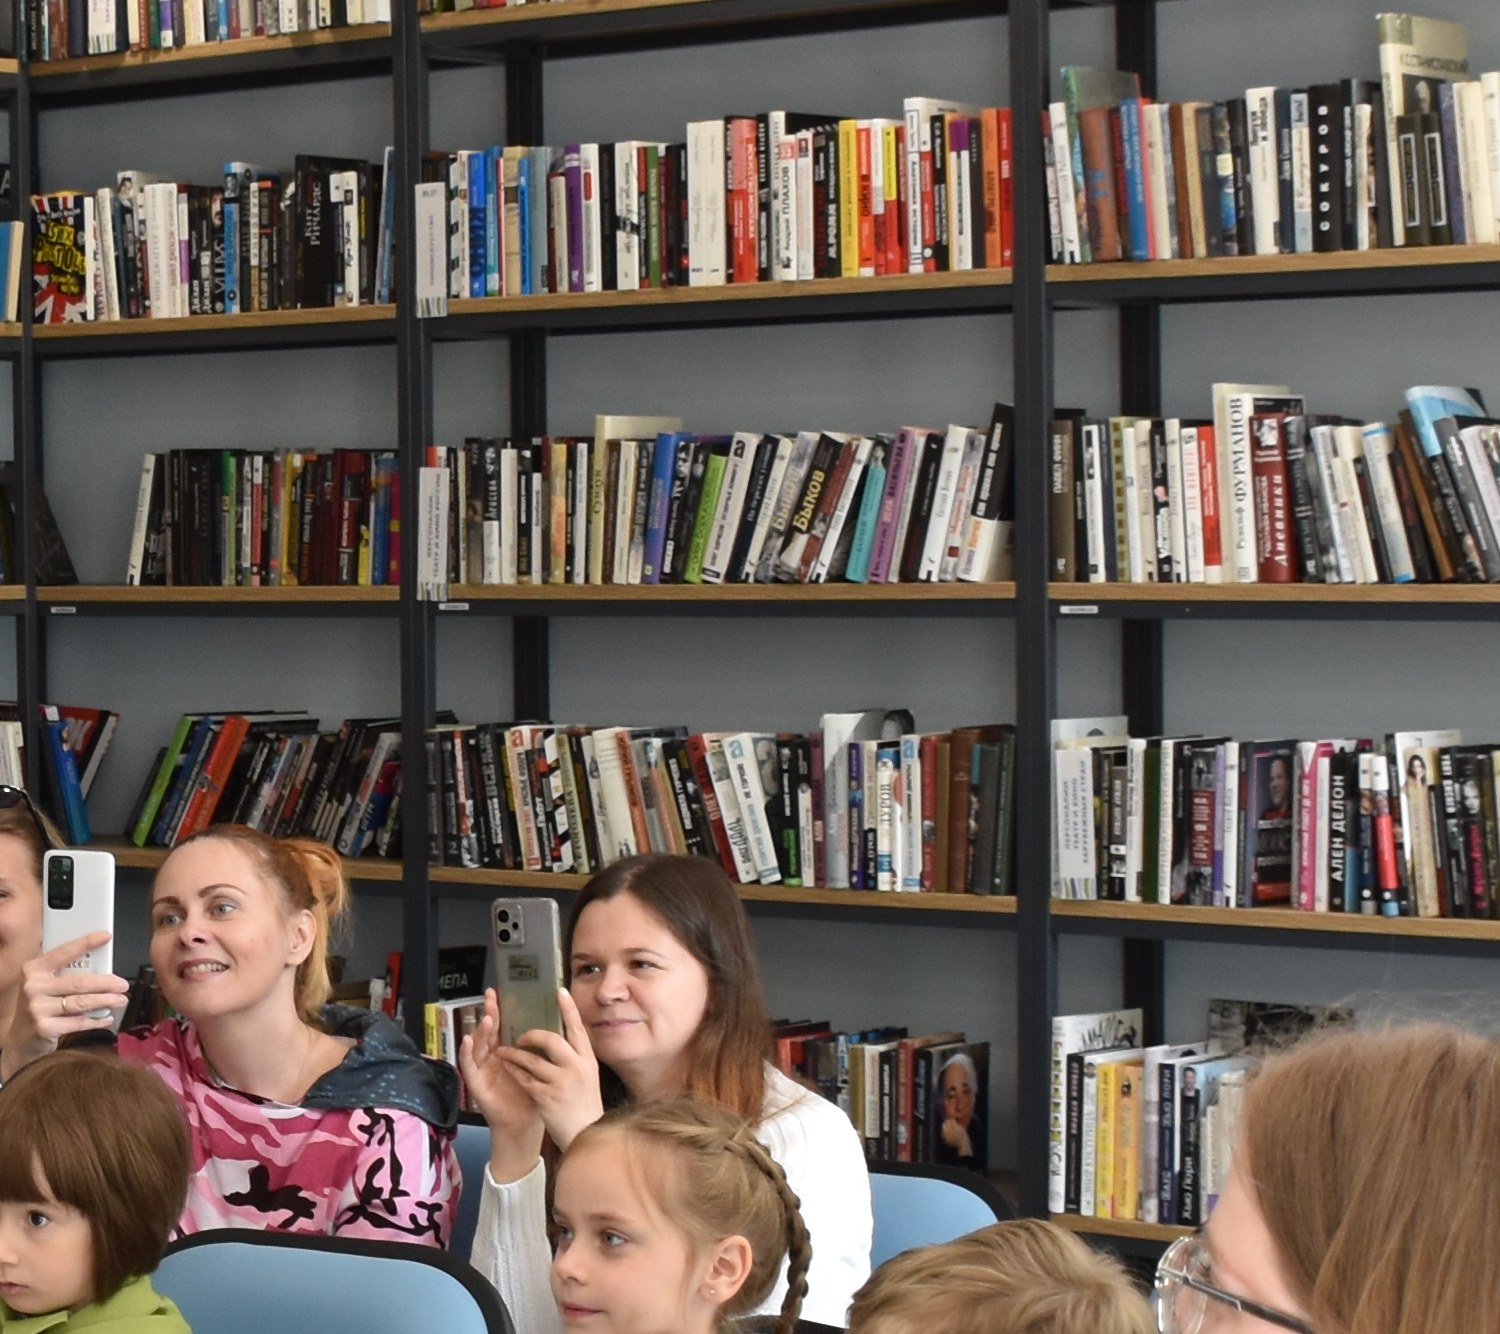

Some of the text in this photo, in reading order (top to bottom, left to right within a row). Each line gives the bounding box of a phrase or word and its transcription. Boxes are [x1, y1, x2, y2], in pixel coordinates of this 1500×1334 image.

[1318, 106, 1331, 231] СОКУРОВ
[1230, 398, 1245, 502] ФУРМАНОВ
[1332, 775, 1345, 882] АЛЕН ДЕЛОН
